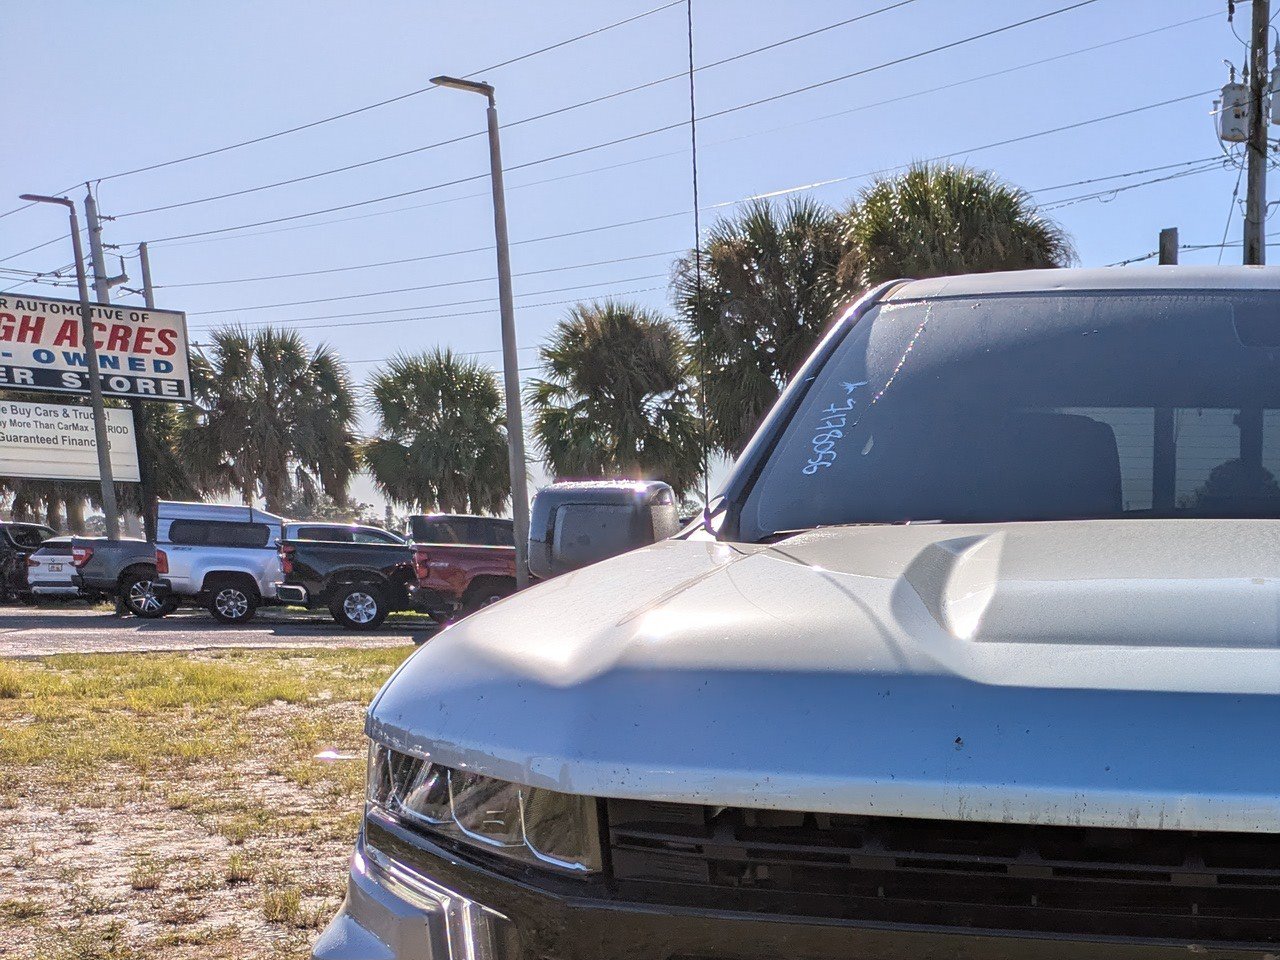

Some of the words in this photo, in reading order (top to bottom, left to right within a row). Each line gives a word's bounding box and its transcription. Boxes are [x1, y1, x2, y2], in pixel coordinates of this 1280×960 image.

[129, 312, 149, 323] OF
[53, 319, 178, 356] ACRES
[33, 348, 173, 374] OWNED
[62, 372, 179, 395] SORE
[10, 405, 31, 417] Buy
[34, 407, 59, 418] Cars
[62, 409, 70, 418] &
[72, 409, 111, 421] Truc!
[10, 419, 32, 428] More
[33, 420, 55, 430] Than
[57, 422, 89, 432] CarMax
[0, 432, 59, 445] Guaranteed
[61, 435, 112, 450] Financg
